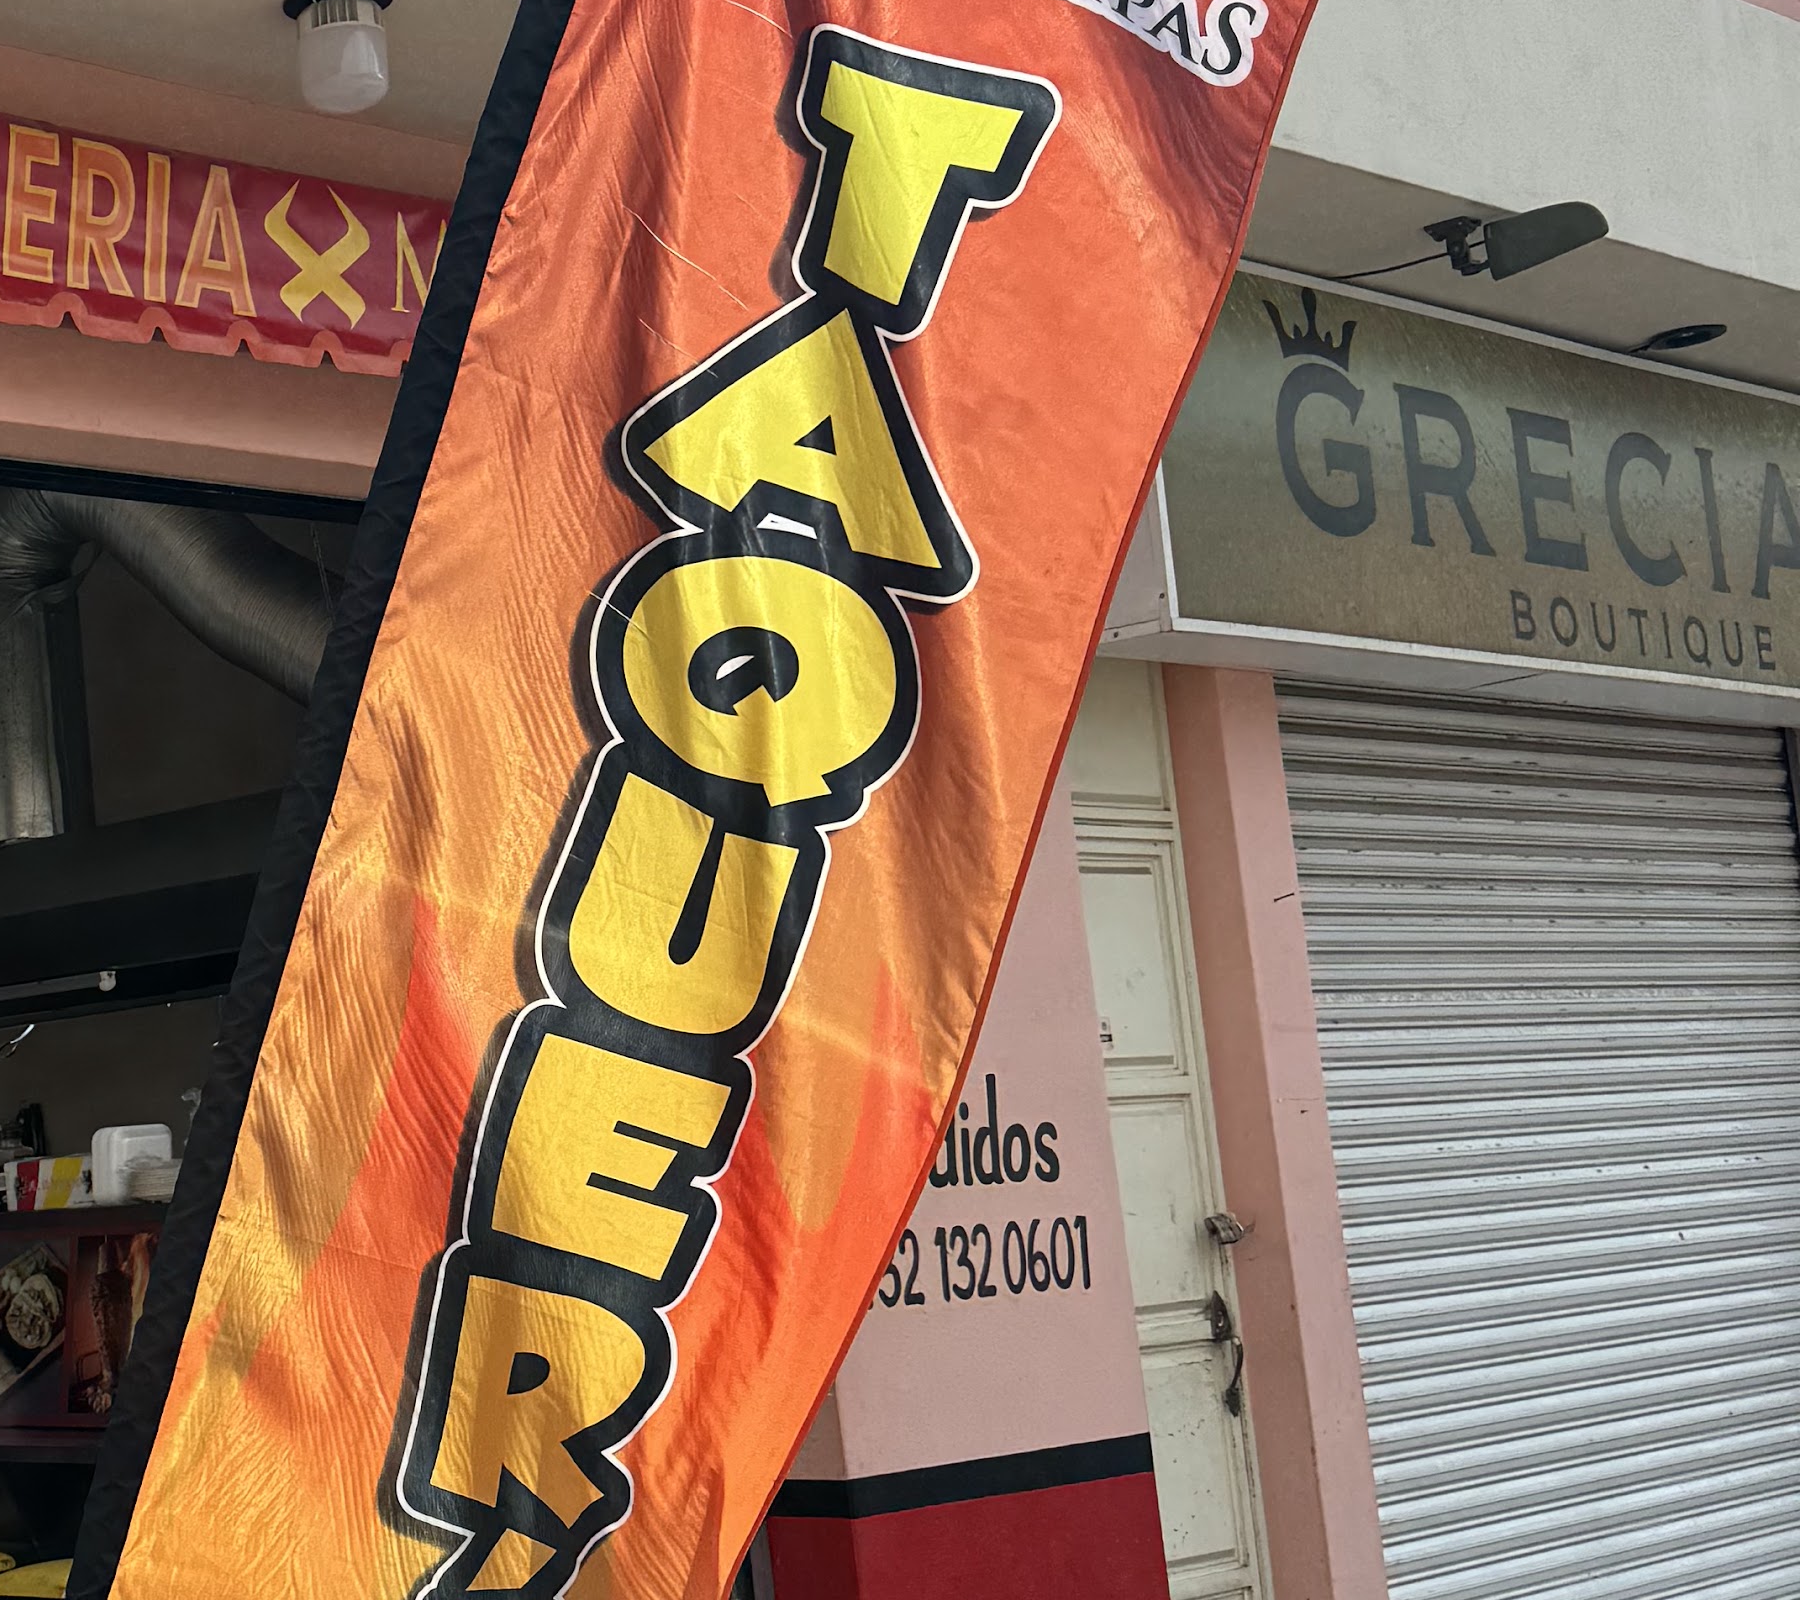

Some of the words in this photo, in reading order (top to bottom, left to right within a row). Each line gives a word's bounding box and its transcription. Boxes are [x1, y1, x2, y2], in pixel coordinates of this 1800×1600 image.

[1510, 589, 1776, 672] BOUTIQUE
[935, 1223, 997, 1302] 132
[1002, 1215, 1091, 1295] 0601
